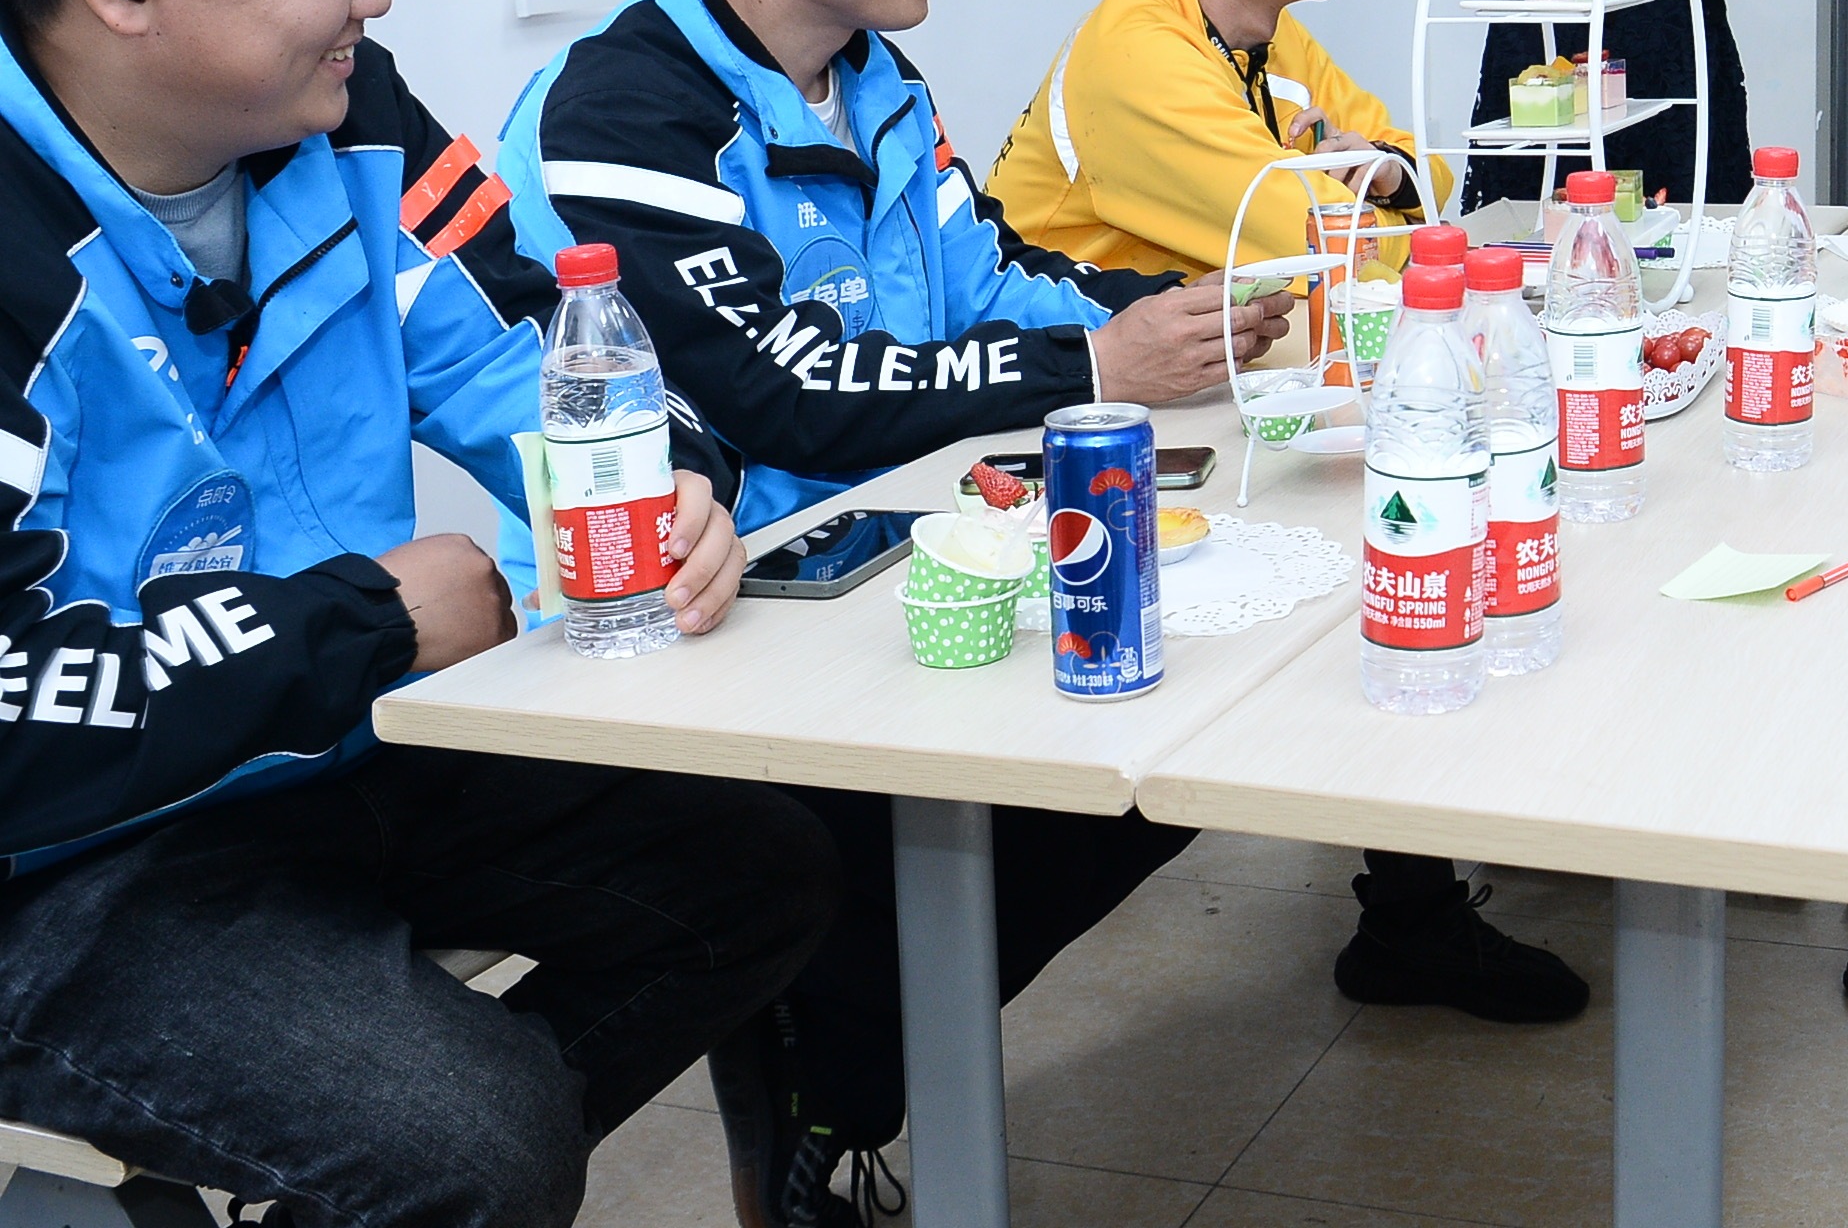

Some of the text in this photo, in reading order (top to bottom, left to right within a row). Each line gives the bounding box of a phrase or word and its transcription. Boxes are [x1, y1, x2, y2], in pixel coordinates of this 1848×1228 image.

[1363, 560, 1448, 600] 农夫山泉
[1052, 590, 1109, 614] 百事可乐
[1397, 600, 1447, 617] SPRING
